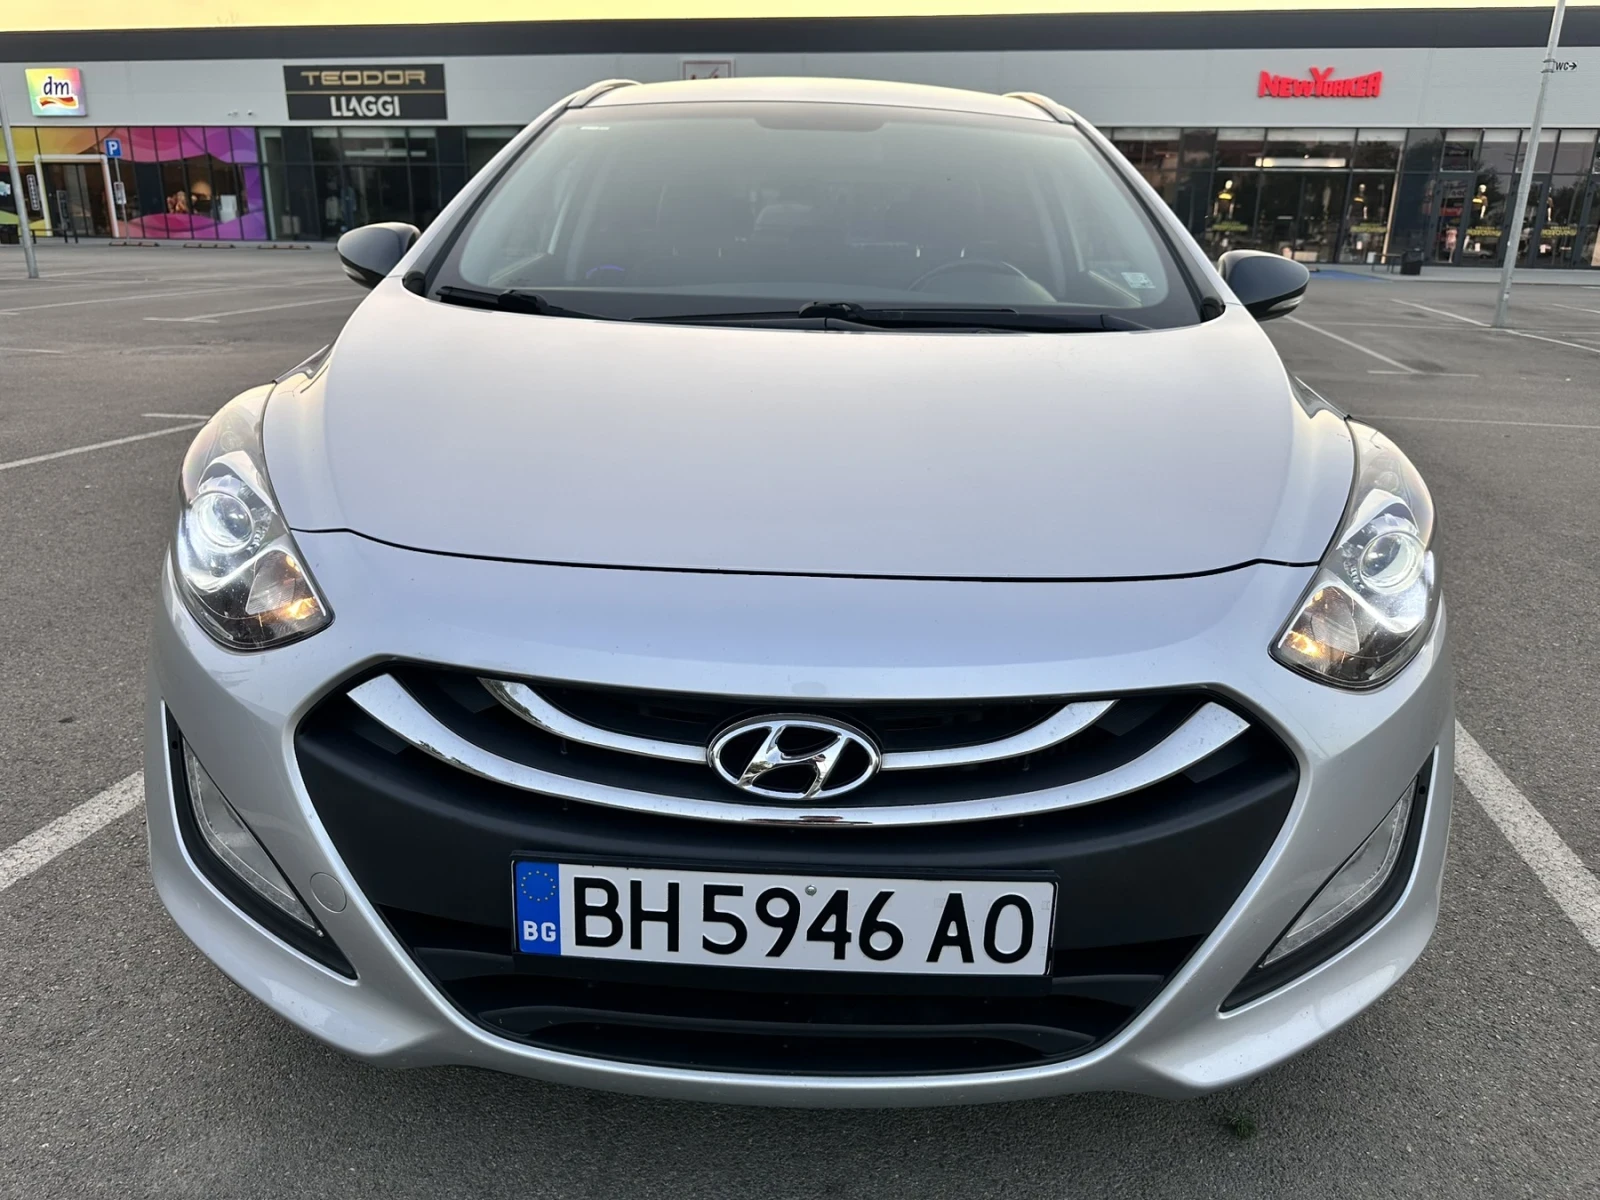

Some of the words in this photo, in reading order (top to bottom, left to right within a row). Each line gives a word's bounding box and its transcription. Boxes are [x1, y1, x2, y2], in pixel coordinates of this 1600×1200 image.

[1555, 61, 1570, 71] WC
[43, 76, 70, 96] dm
[300, 69, 426, 86] TEODOR
[108, 140, 118, 155] P
[573, 876, 680, 953] BH
[702, 883, 904, 962] 5946
[925, 891, 1035, 966] AO
[523, 920, 557, 943] BG
